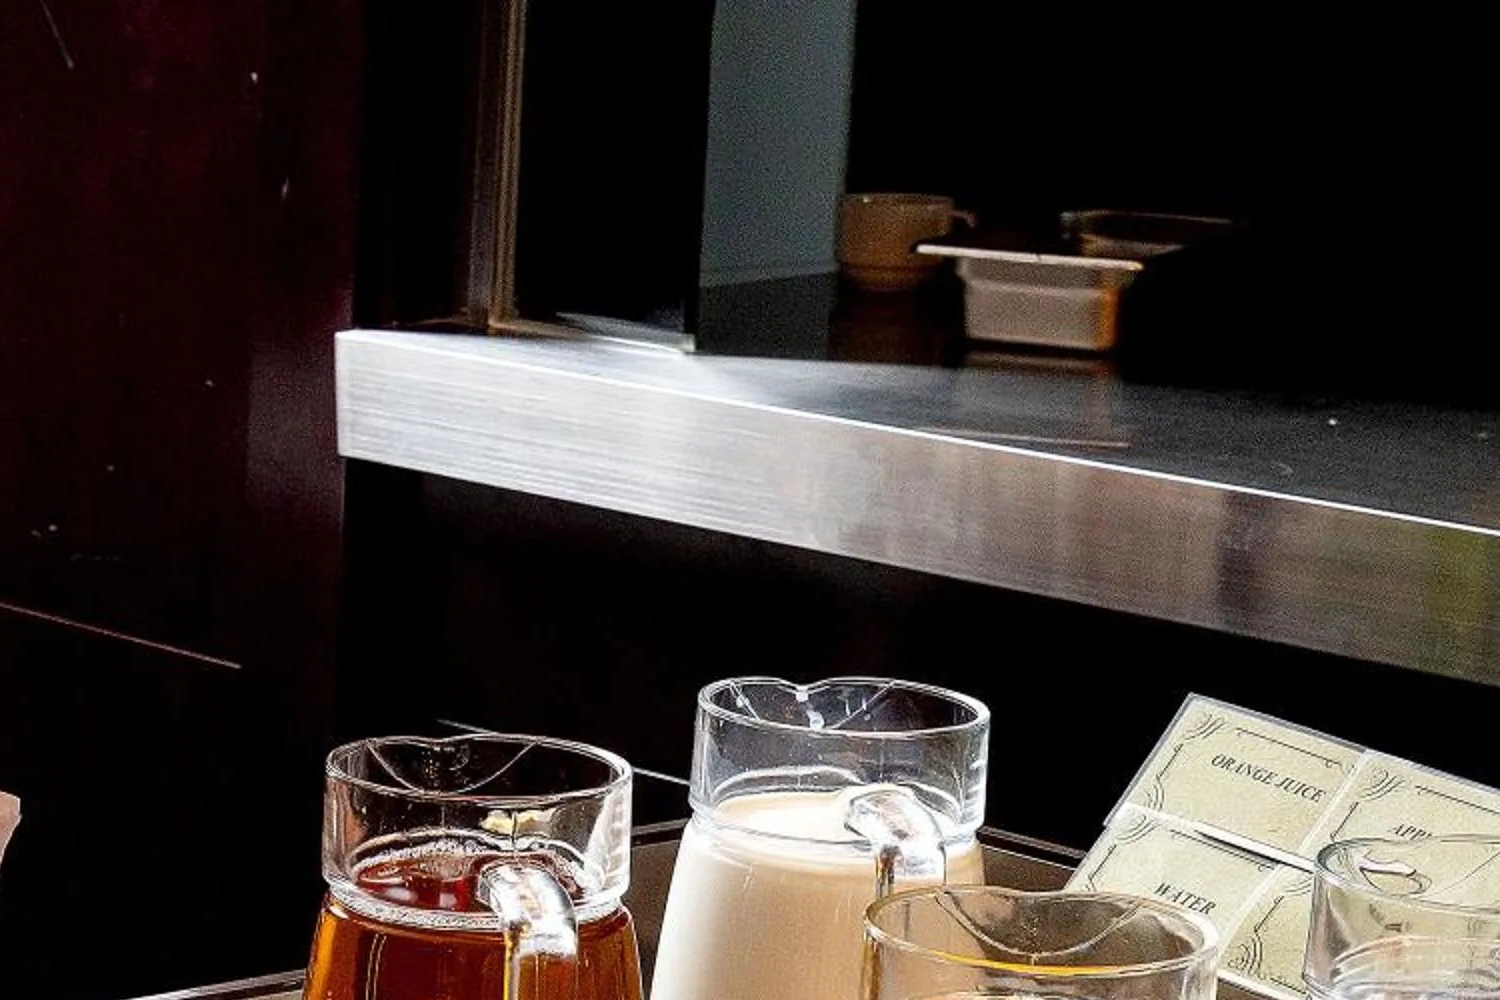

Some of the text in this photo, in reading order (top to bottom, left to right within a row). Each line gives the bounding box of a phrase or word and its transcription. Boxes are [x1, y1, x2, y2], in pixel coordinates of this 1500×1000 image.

[1211, 753, 1326, 803] ORANGE JUICE
[1387, 823, 1432, 840] APP
[1154, 883, 1216, 914] WATER
